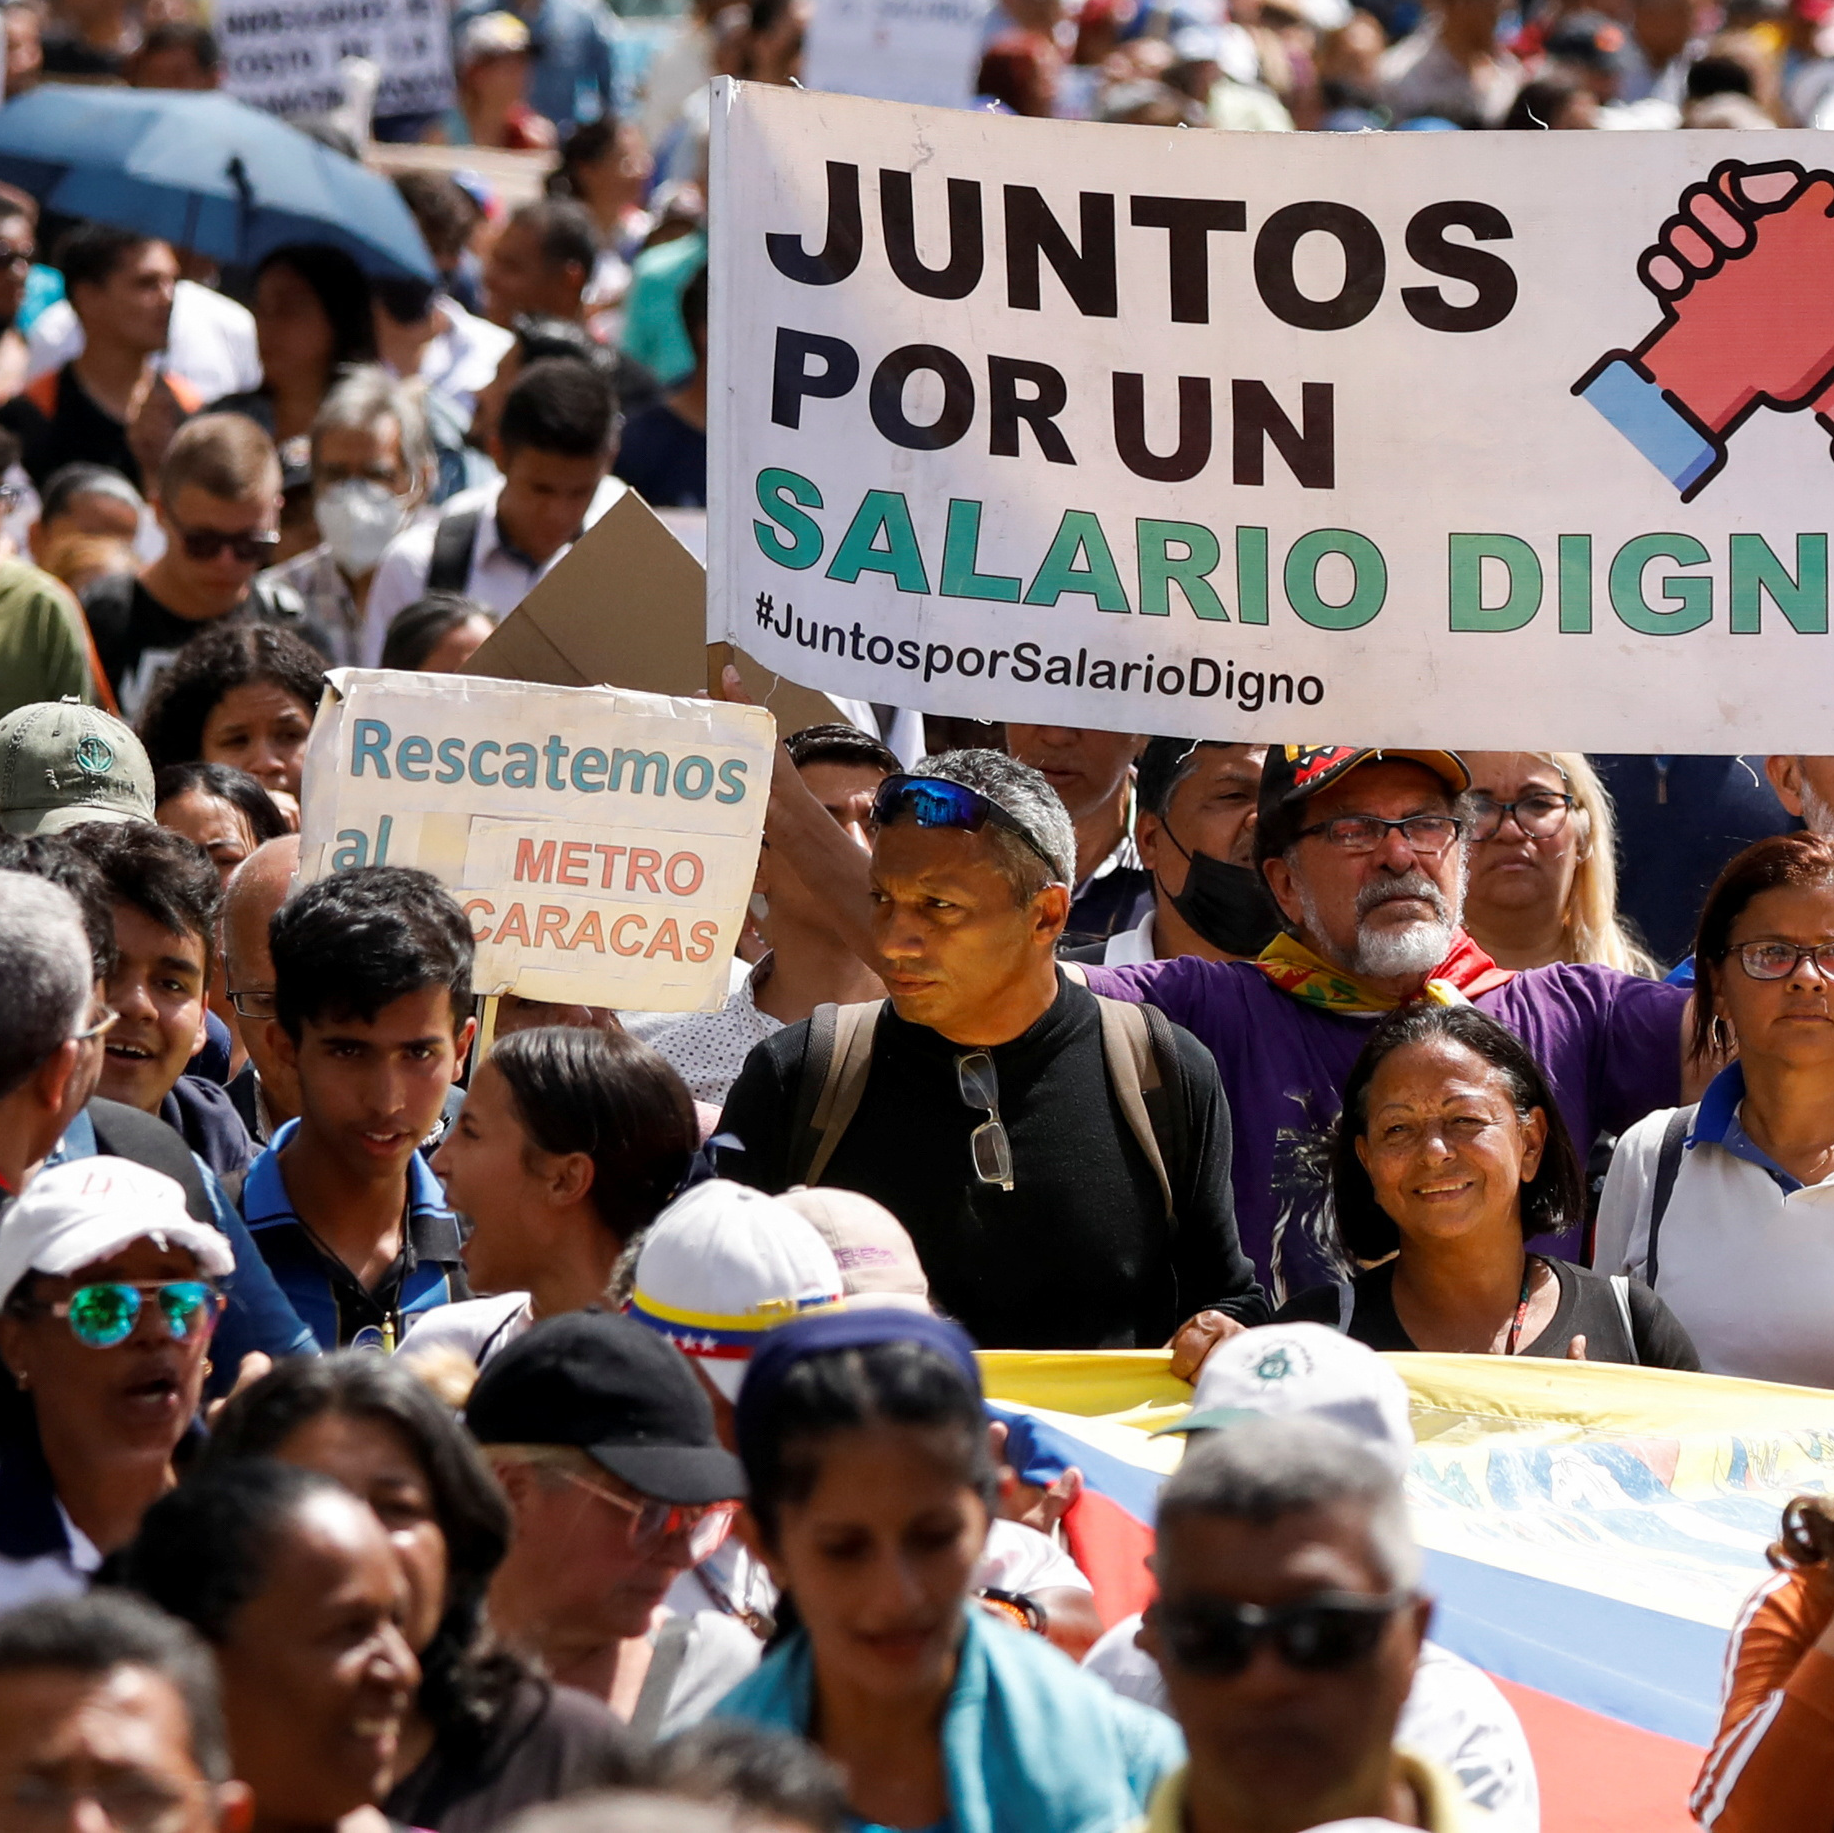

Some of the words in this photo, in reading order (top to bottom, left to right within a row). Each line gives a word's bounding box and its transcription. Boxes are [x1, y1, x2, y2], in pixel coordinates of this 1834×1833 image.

[765, 161, 1518, 333] JUNTOS
[771, 327, 1076, 466] POR
[1113, 372, 1335, 489] UN
[753, 467, 1388, 631] SALARIO
[755, 592, 1325, 712] #JuntosporSalarioDigno
[351, 718, 748, 805] Rescatemos
[332, 815, 394, 872] al
[514, 838, 705, 897] METRO
[463, 898, 719, 963] CARACAS
